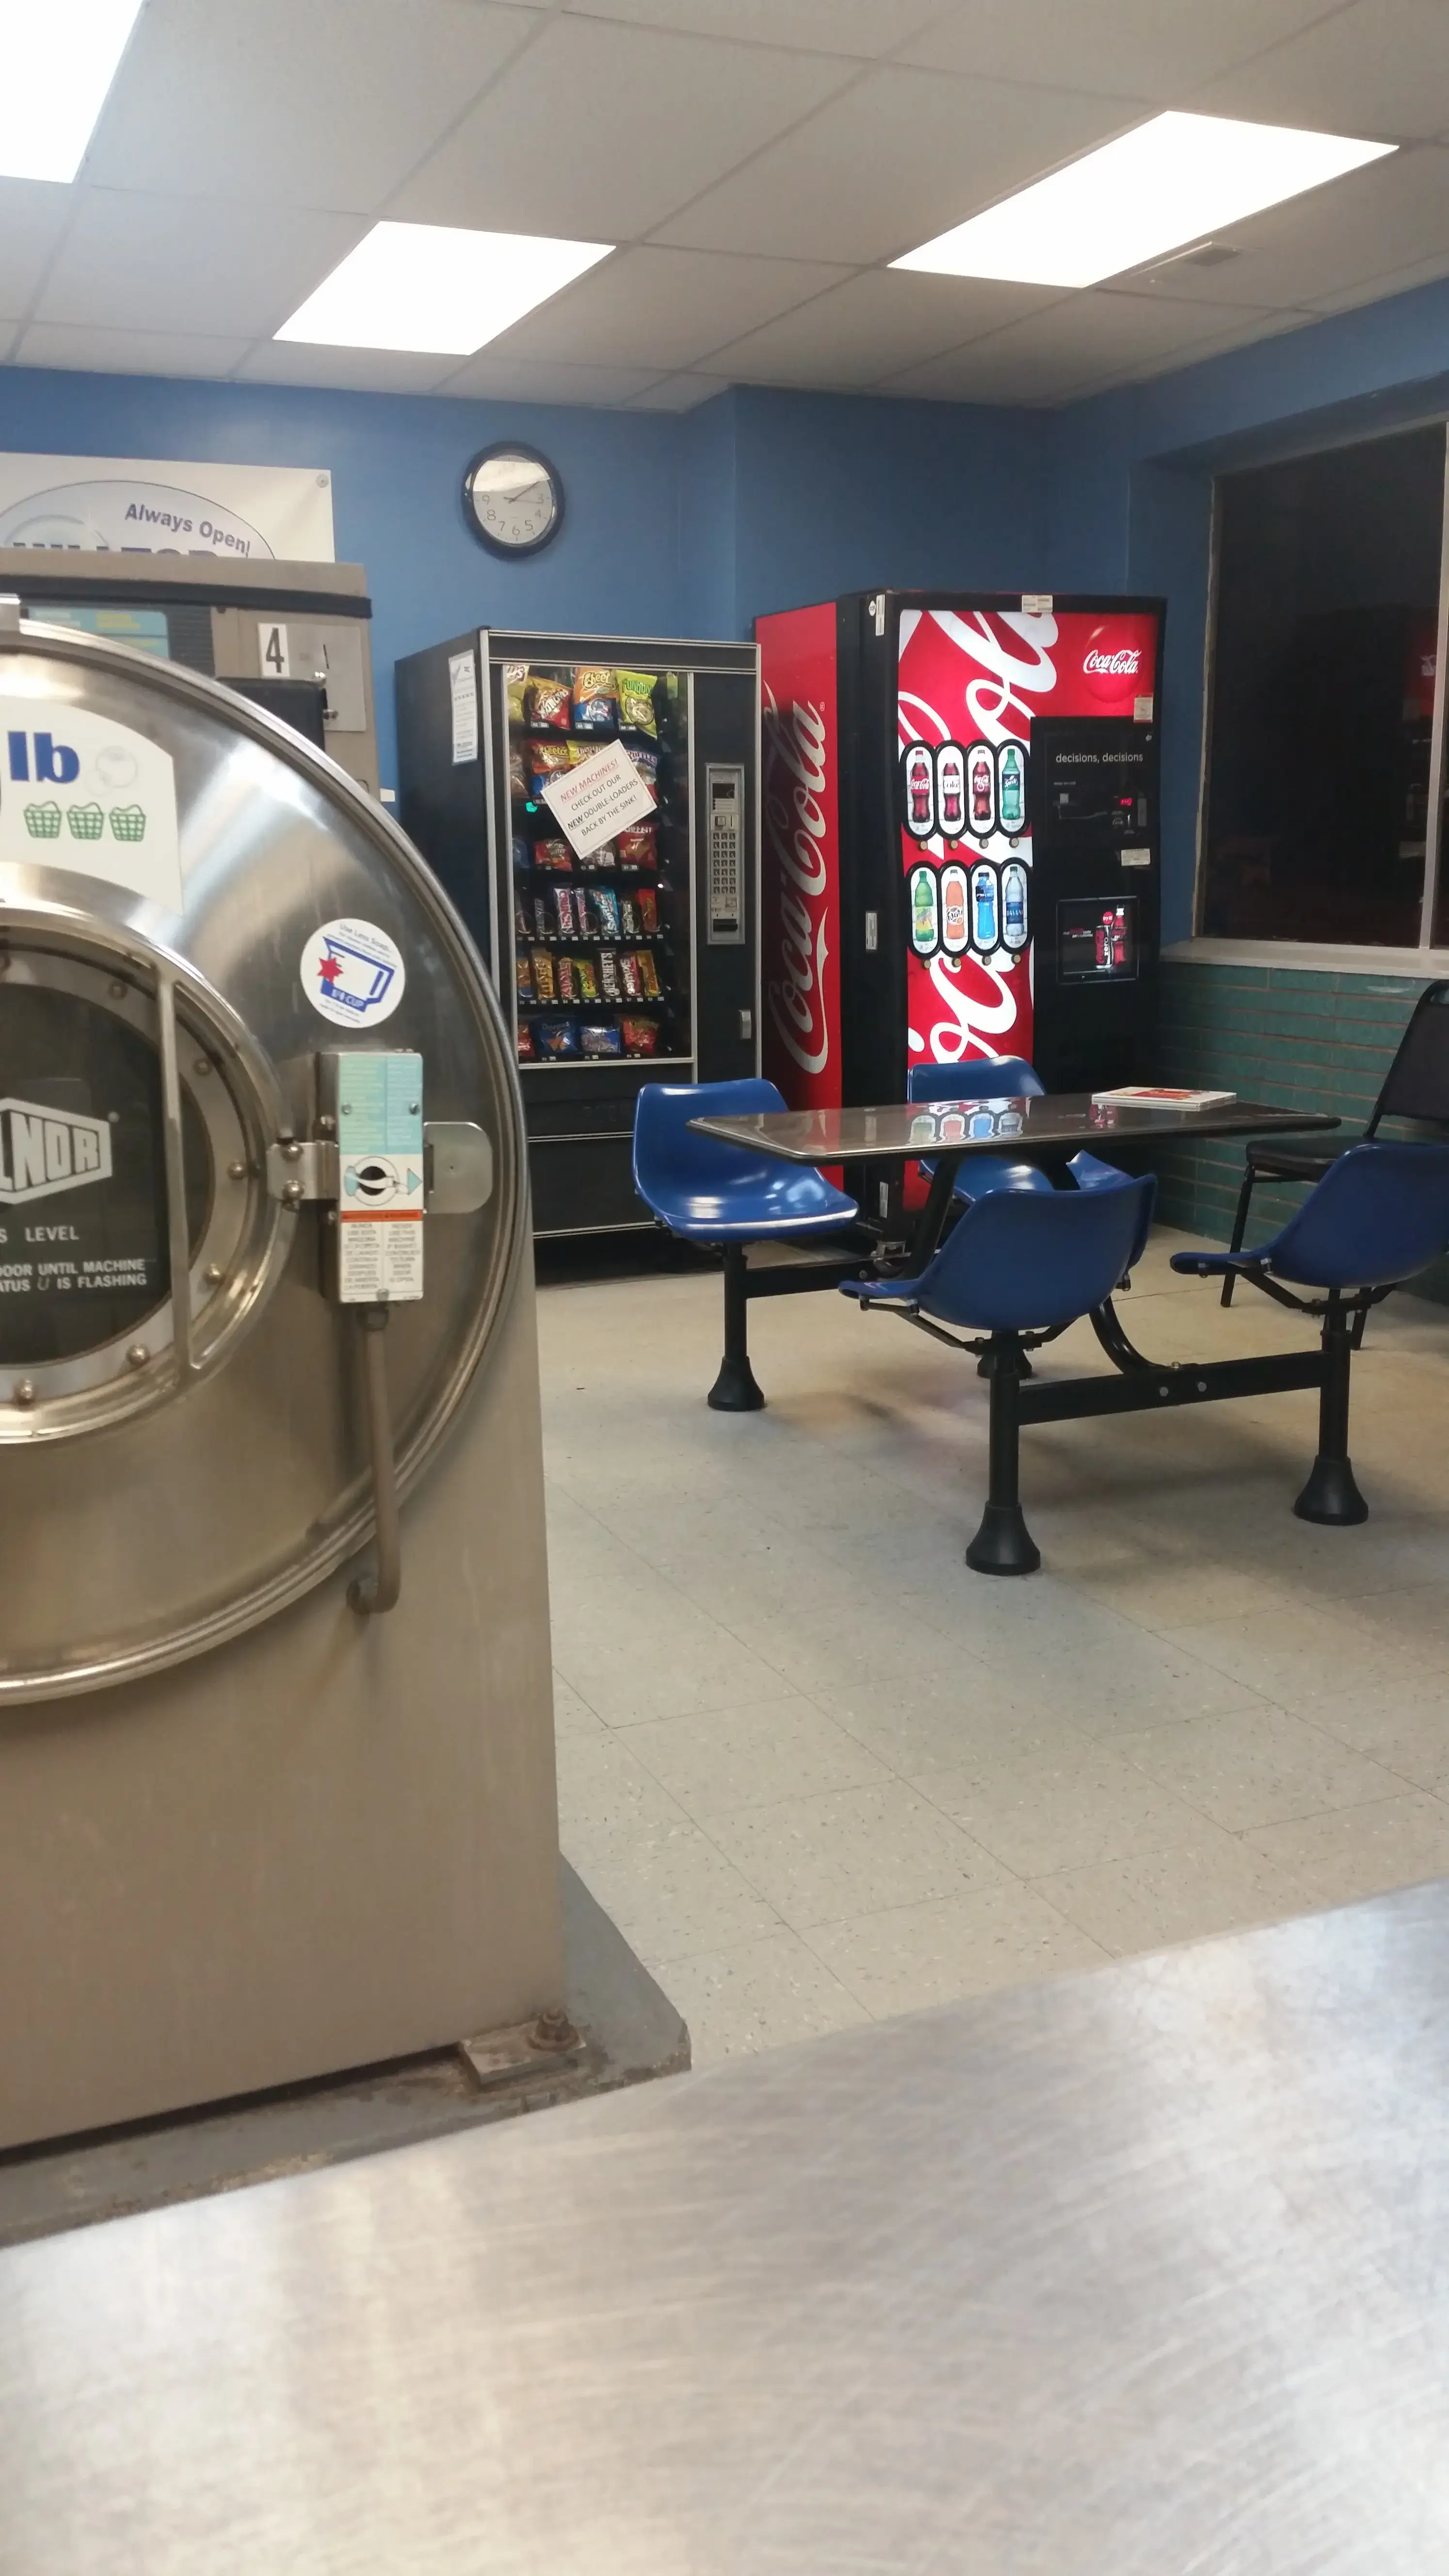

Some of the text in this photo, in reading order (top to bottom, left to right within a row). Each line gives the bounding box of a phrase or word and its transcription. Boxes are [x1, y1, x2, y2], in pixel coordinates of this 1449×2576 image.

[482, 495, 490, 505] 9
[536, 494, 544, 504] 3
[486, 509, 496, 520] 8
[534, 509, 541, 519] 4
[125, 503, 193, 532] Always
[199, 521, 251, 558] Open!
[498, 521, 505, 531] 7
[512, 525, 520, 535] 6
[525, 520, 533, 531] 5
[266, 628, 285, 673] 4
[1082, 649, 1143, 675] Coca-Cola
[7, 731, 80, 784] lb
[1056, 753, 1143, 764] decisions, decisions
[560, 758, 620, 803] NEW MACHINES!
[571, 774, 622, 811] CHECK OUT OUR
[567, 778, 639, 830] NEW DOUBLE-LOADERS
[580, 795, 638, 836] BACK BY THE SINK!
[763, 683, 828, 1075] Coca-Cola
[25, 1226, 80, 1242] LEVEL
[38, 1261, 79, 1275] UNTIL
[83, 1258, 145, 1273] MACHINE
[57, 1277, 71, 1289] IS
[78, 1273, 147, 1288] FLASHING
